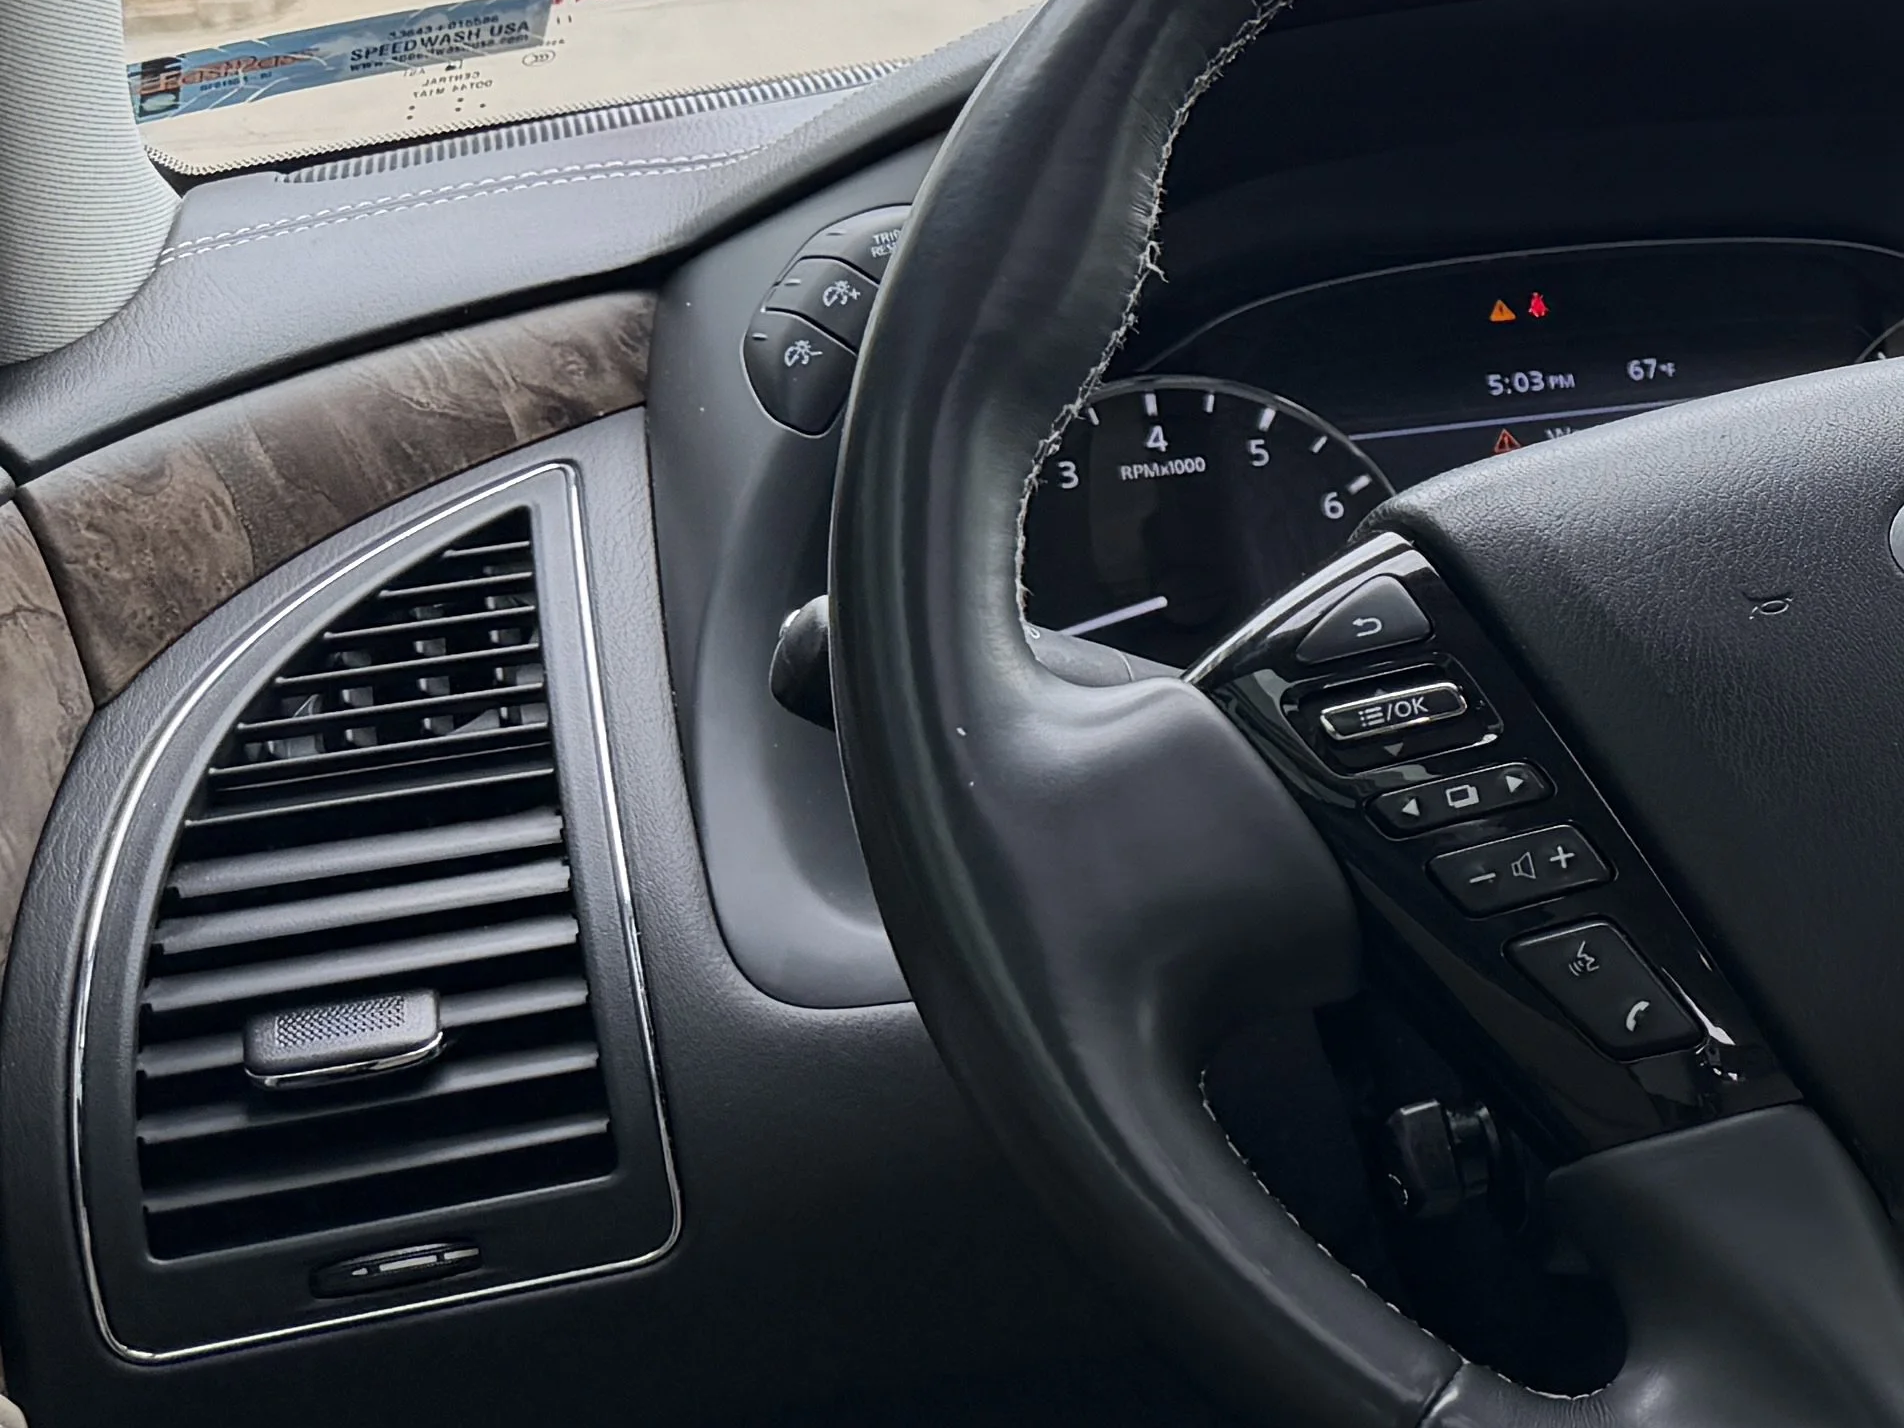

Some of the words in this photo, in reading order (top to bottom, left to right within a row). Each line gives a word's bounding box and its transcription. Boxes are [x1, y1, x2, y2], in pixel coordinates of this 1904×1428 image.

[490, 21, 530, 38] USA
[1486, 370, 1545, 396] 5:03
[1146, 424, 1169, 453] 4
[1248, 439, 1271, 467] 5
[1057, 460, 1079, 490] 3
[1320, 491, 1345, 520] 6
